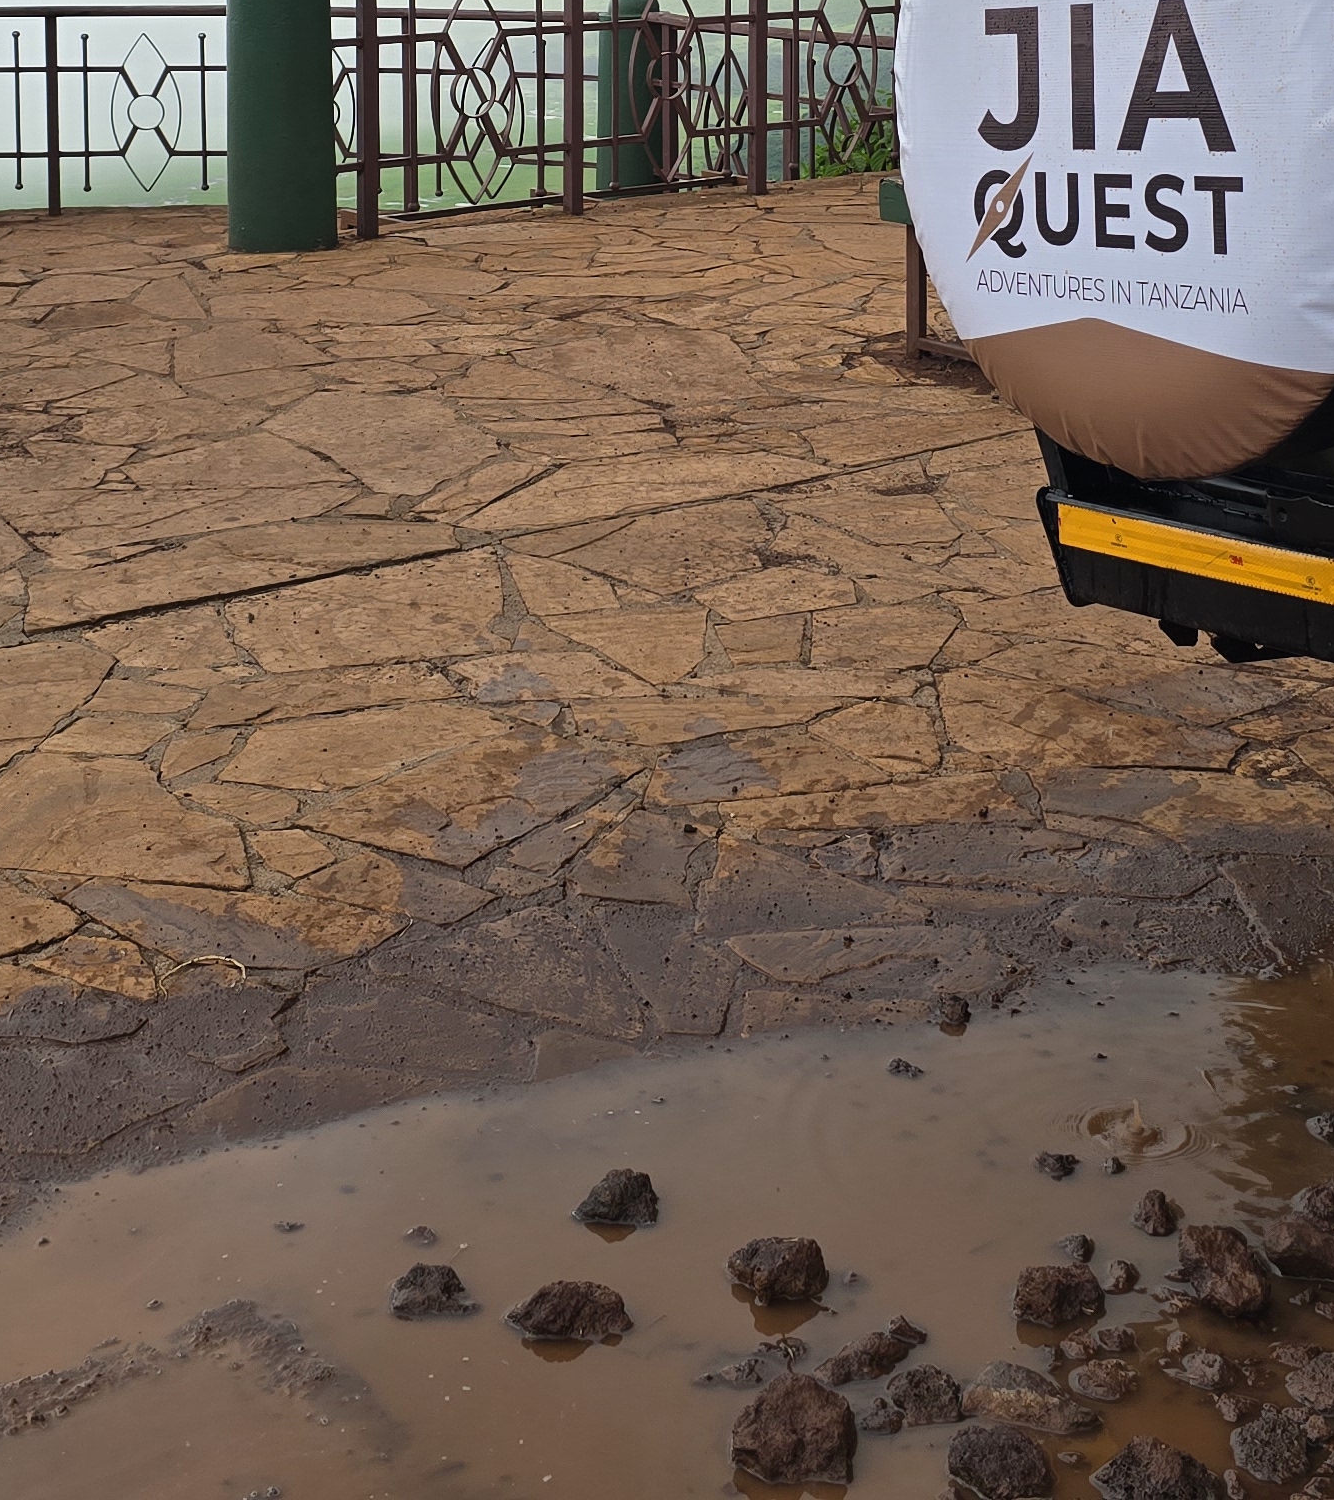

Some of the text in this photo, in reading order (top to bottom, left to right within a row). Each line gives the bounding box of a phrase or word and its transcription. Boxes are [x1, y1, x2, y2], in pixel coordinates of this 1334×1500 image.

[975, 168, 1245, 259] QUEST
[976, 268, 1250, 316] ADVENTURES IN TANZANIA
[1228, 553, 1244, 567] 3M
